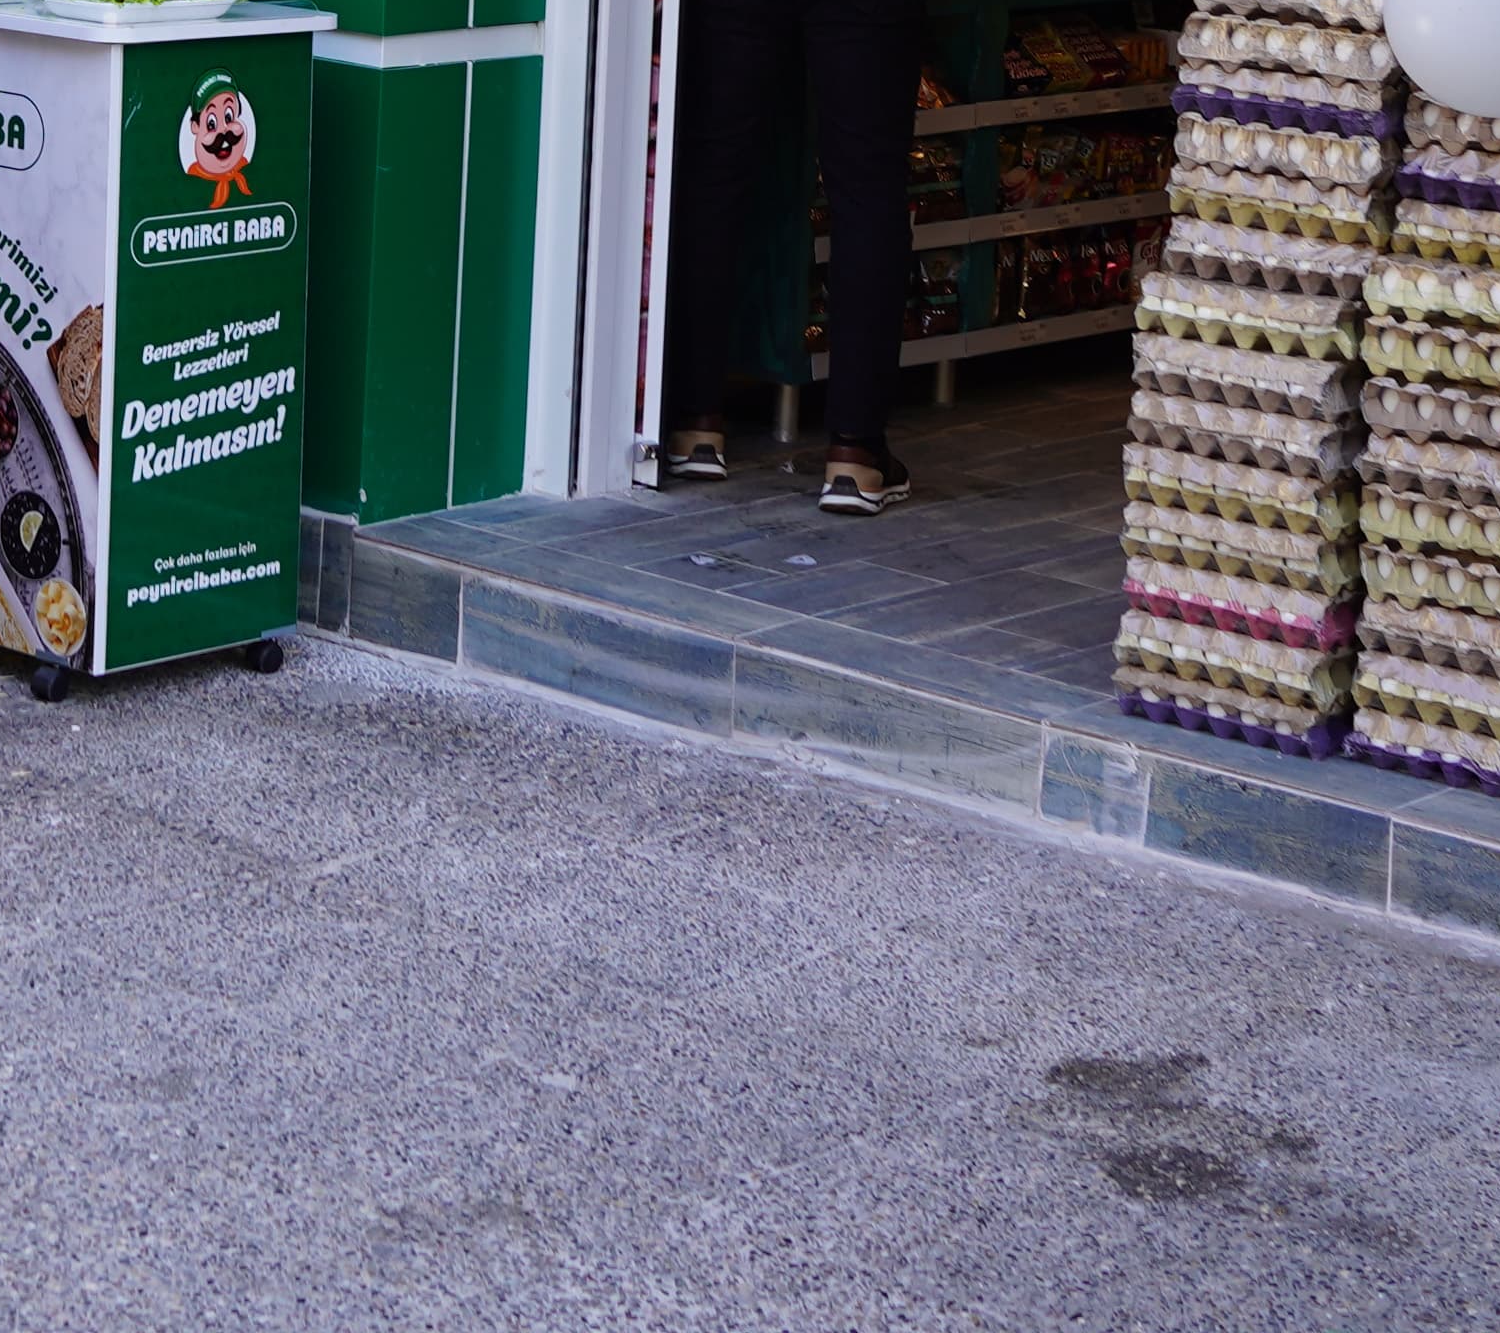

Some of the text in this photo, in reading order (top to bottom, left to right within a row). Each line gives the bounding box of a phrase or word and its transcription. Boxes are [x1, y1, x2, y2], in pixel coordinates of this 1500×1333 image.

[233, 214, 286, 244] BABA
[141, 311, 281, 366] Benzersiz Yöresel
[173, 343, 250, 382] Lezzetleri
[121, 366, 297, 440] Denemeyen
[131, 404, 288, 484] Kalmasın!
[154, 540, 257, 574] Çok daha fazlası için
[126, 558, 282, 608] peynircibaba.com
